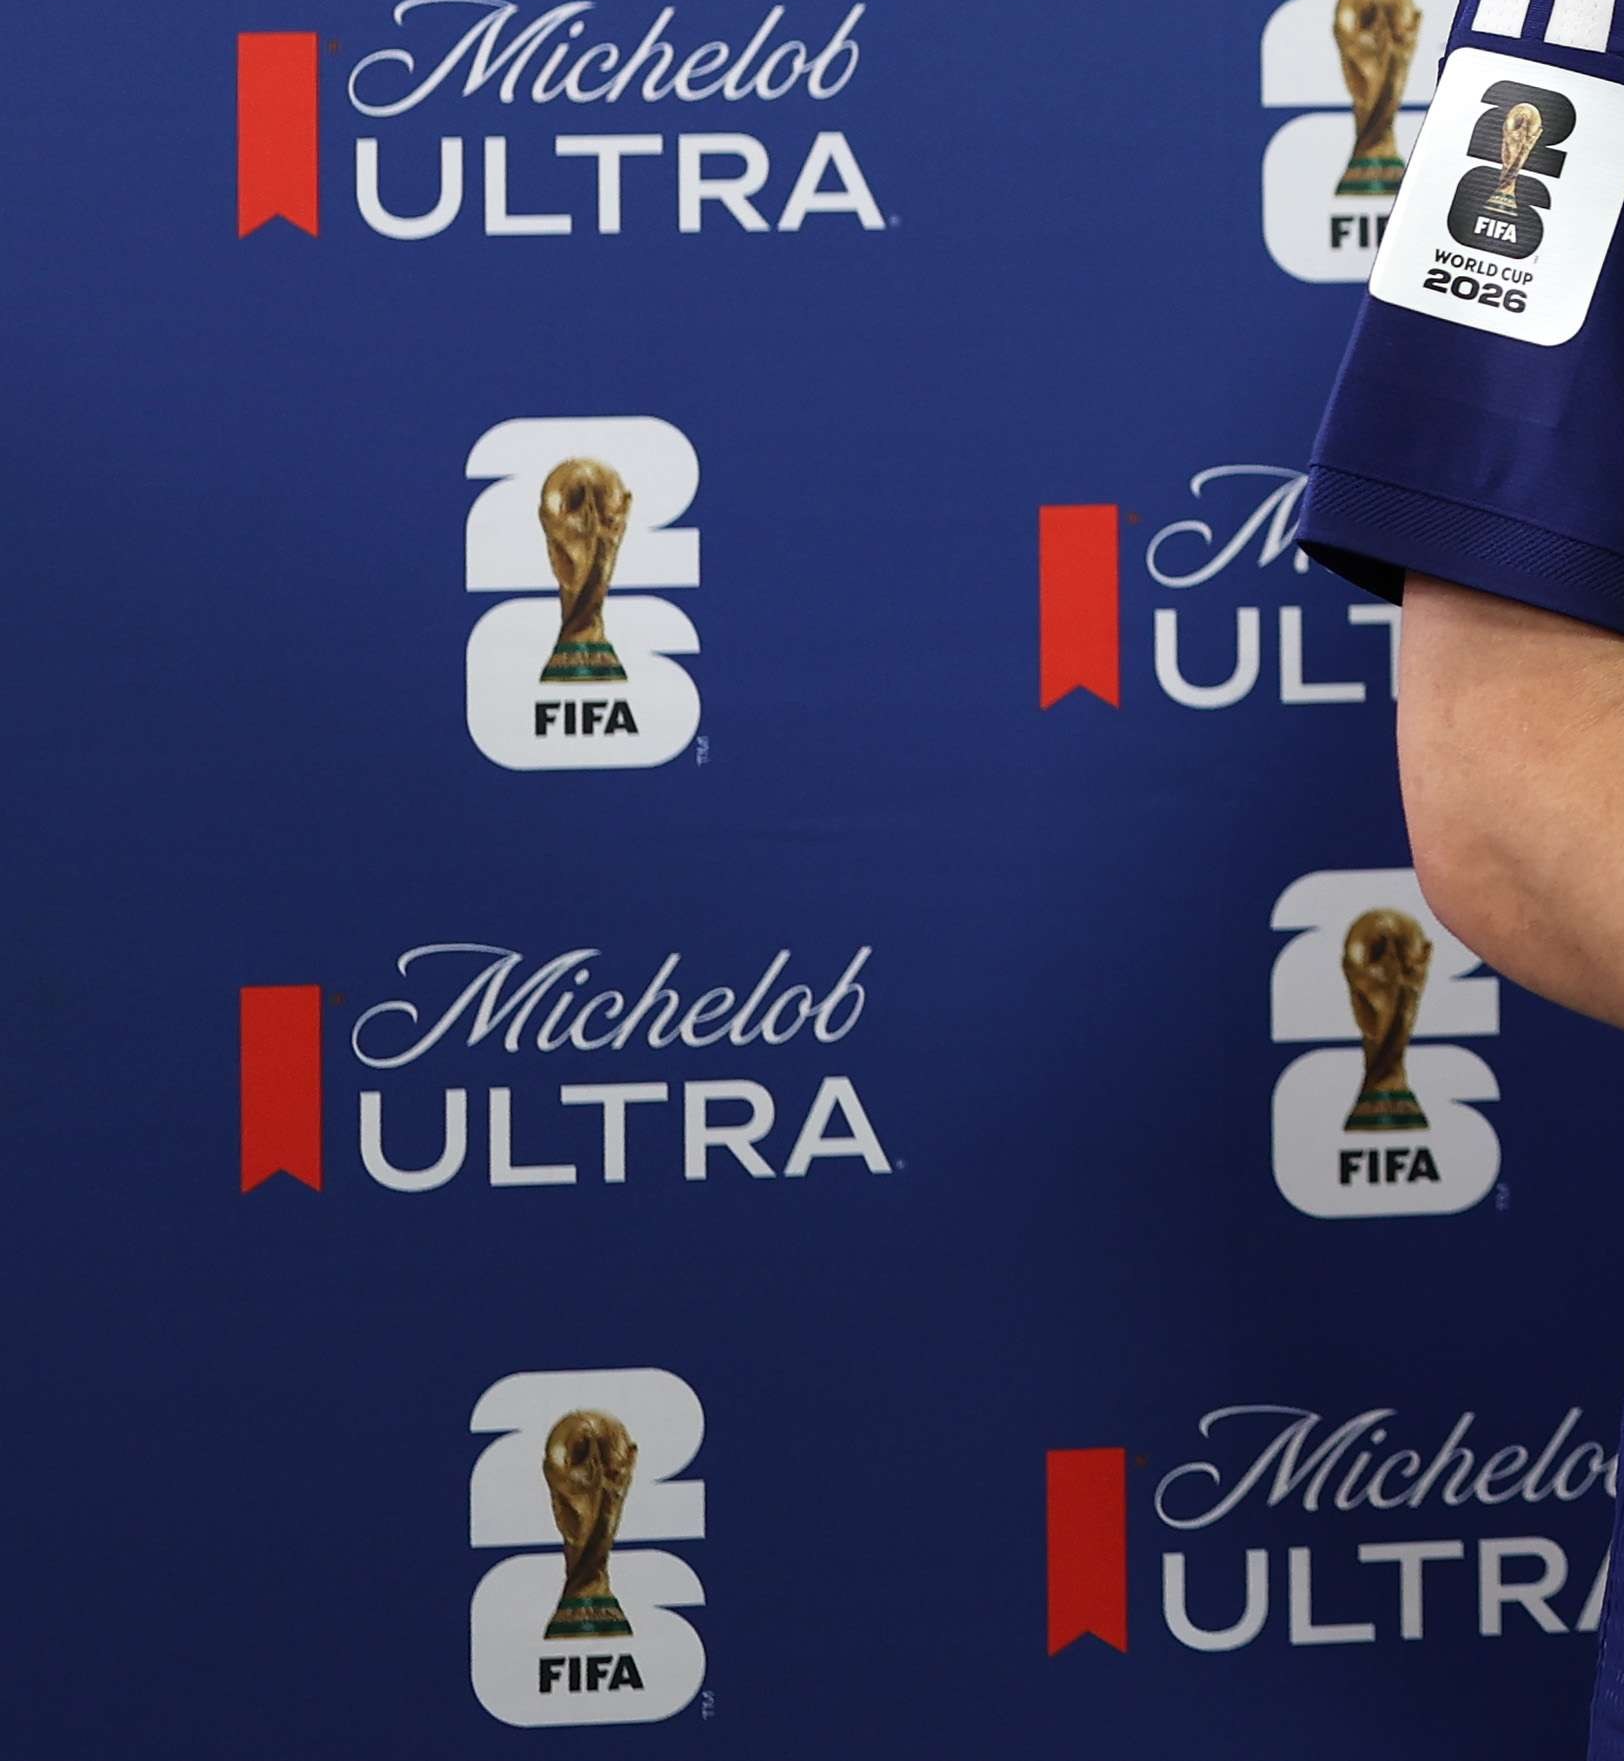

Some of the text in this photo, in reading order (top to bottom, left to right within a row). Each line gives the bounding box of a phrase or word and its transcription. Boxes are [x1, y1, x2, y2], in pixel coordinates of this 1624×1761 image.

[356, 132, 885, 239] ULTRA
[1329, 215, 1390, 249] FI
[1474, 216, 1517, 243] FIFA
[1434, 249, 1533, 285] WORLD CUP
[1423, 268, 1527, 313] 2026
[1155, 604, 1402, 710] ULT
[535, 701, 638, 736] FIFA
[352, 944, 872, 1068] Michelob
[360, 1077, 891, 1191] ULTRA
[1340, 1148, 1440, 1185] FIFA
[539, 1655, 643, 1693] FIFA
